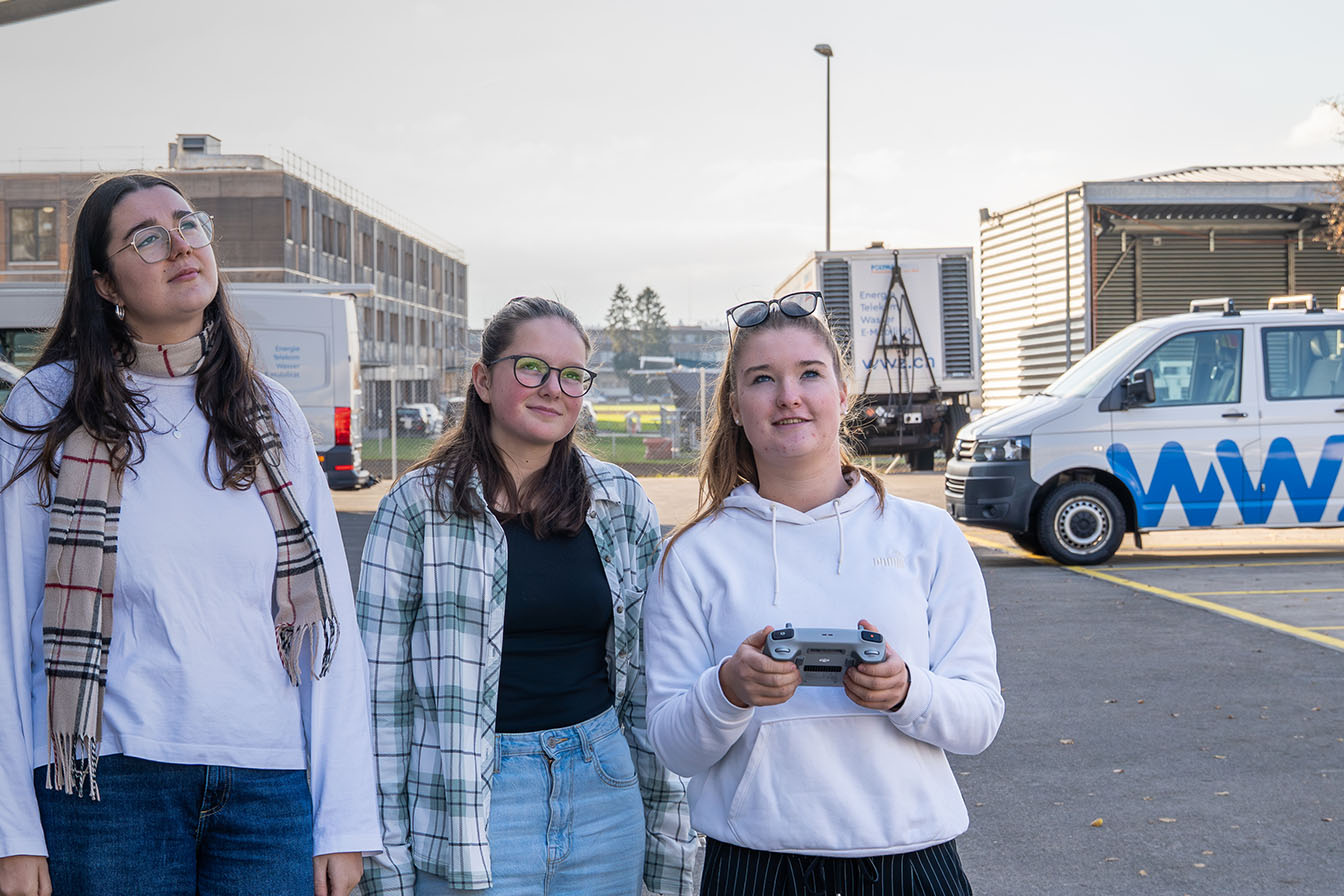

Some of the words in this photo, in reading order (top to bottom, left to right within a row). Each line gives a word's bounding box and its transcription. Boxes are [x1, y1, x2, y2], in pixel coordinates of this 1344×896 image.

[859, 291, 896, 300] Energe
[860, 303, 897, 312] Telekm
[860, 316, 895, 324] Waser
[1106, 434, 1344, 527] WW
